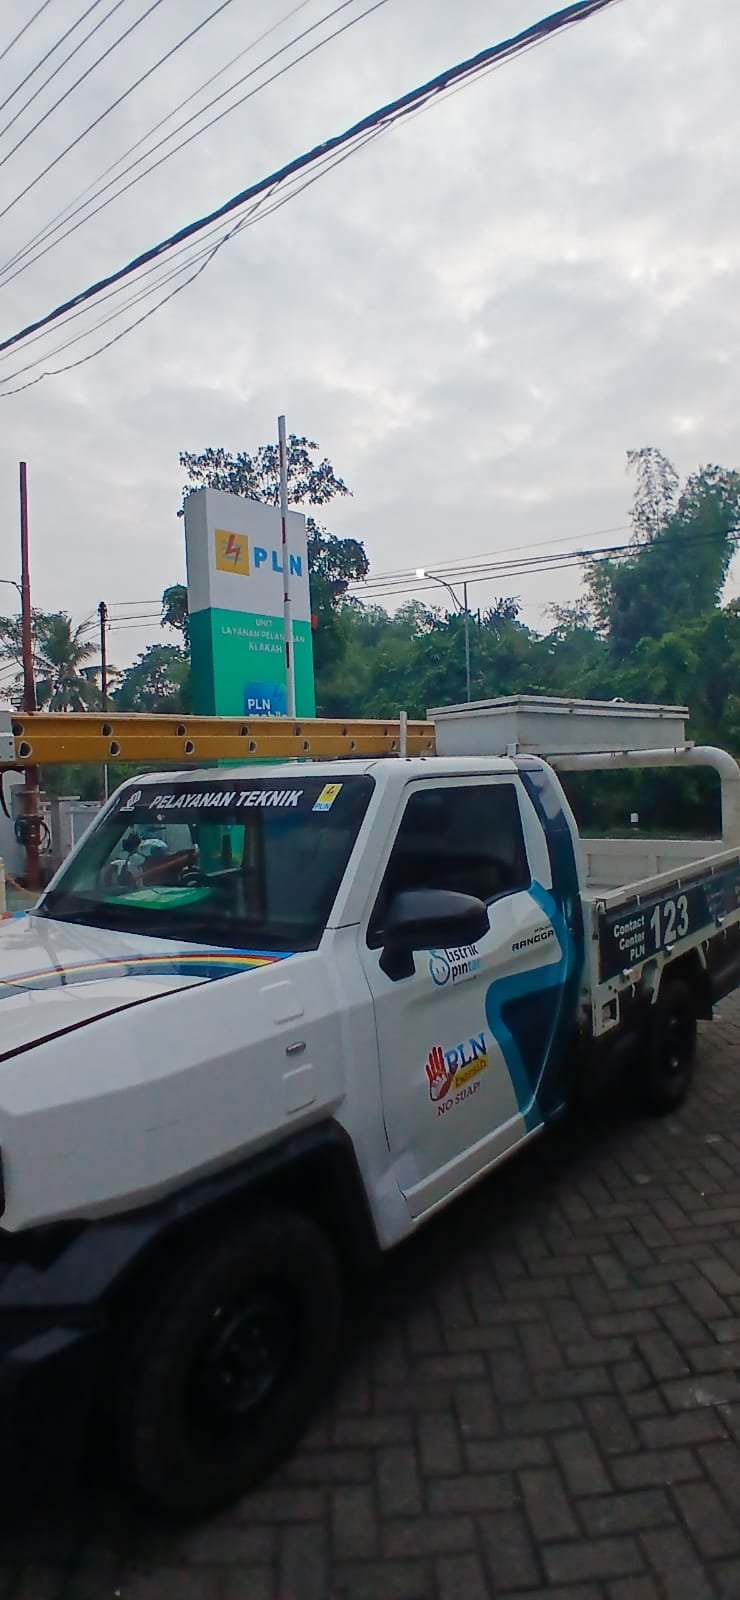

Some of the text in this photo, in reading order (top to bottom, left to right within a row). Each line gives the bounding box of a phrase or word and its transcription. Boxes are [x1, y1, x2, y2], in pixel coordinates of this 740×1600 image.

[254, 546, 302, 576] PLN
[221, 626, 260, 638] LAYANAN
[255, 618, 272, 627] UNIT
[247, 698, 271, 710] PLN
[148, 790, 304, 809] PELAYANAN TEKNIK
[613, 915, 645, 938] Contact
[650, 895, 689, 949] 123
[511, 929, 554, 951] RANGGA
[619, 931, 645, 950] Center
[630, 944, 646, 961] PLN
[445, 1031, 487, 1076] PLN
[437, 1099, 453, 1116] NO
